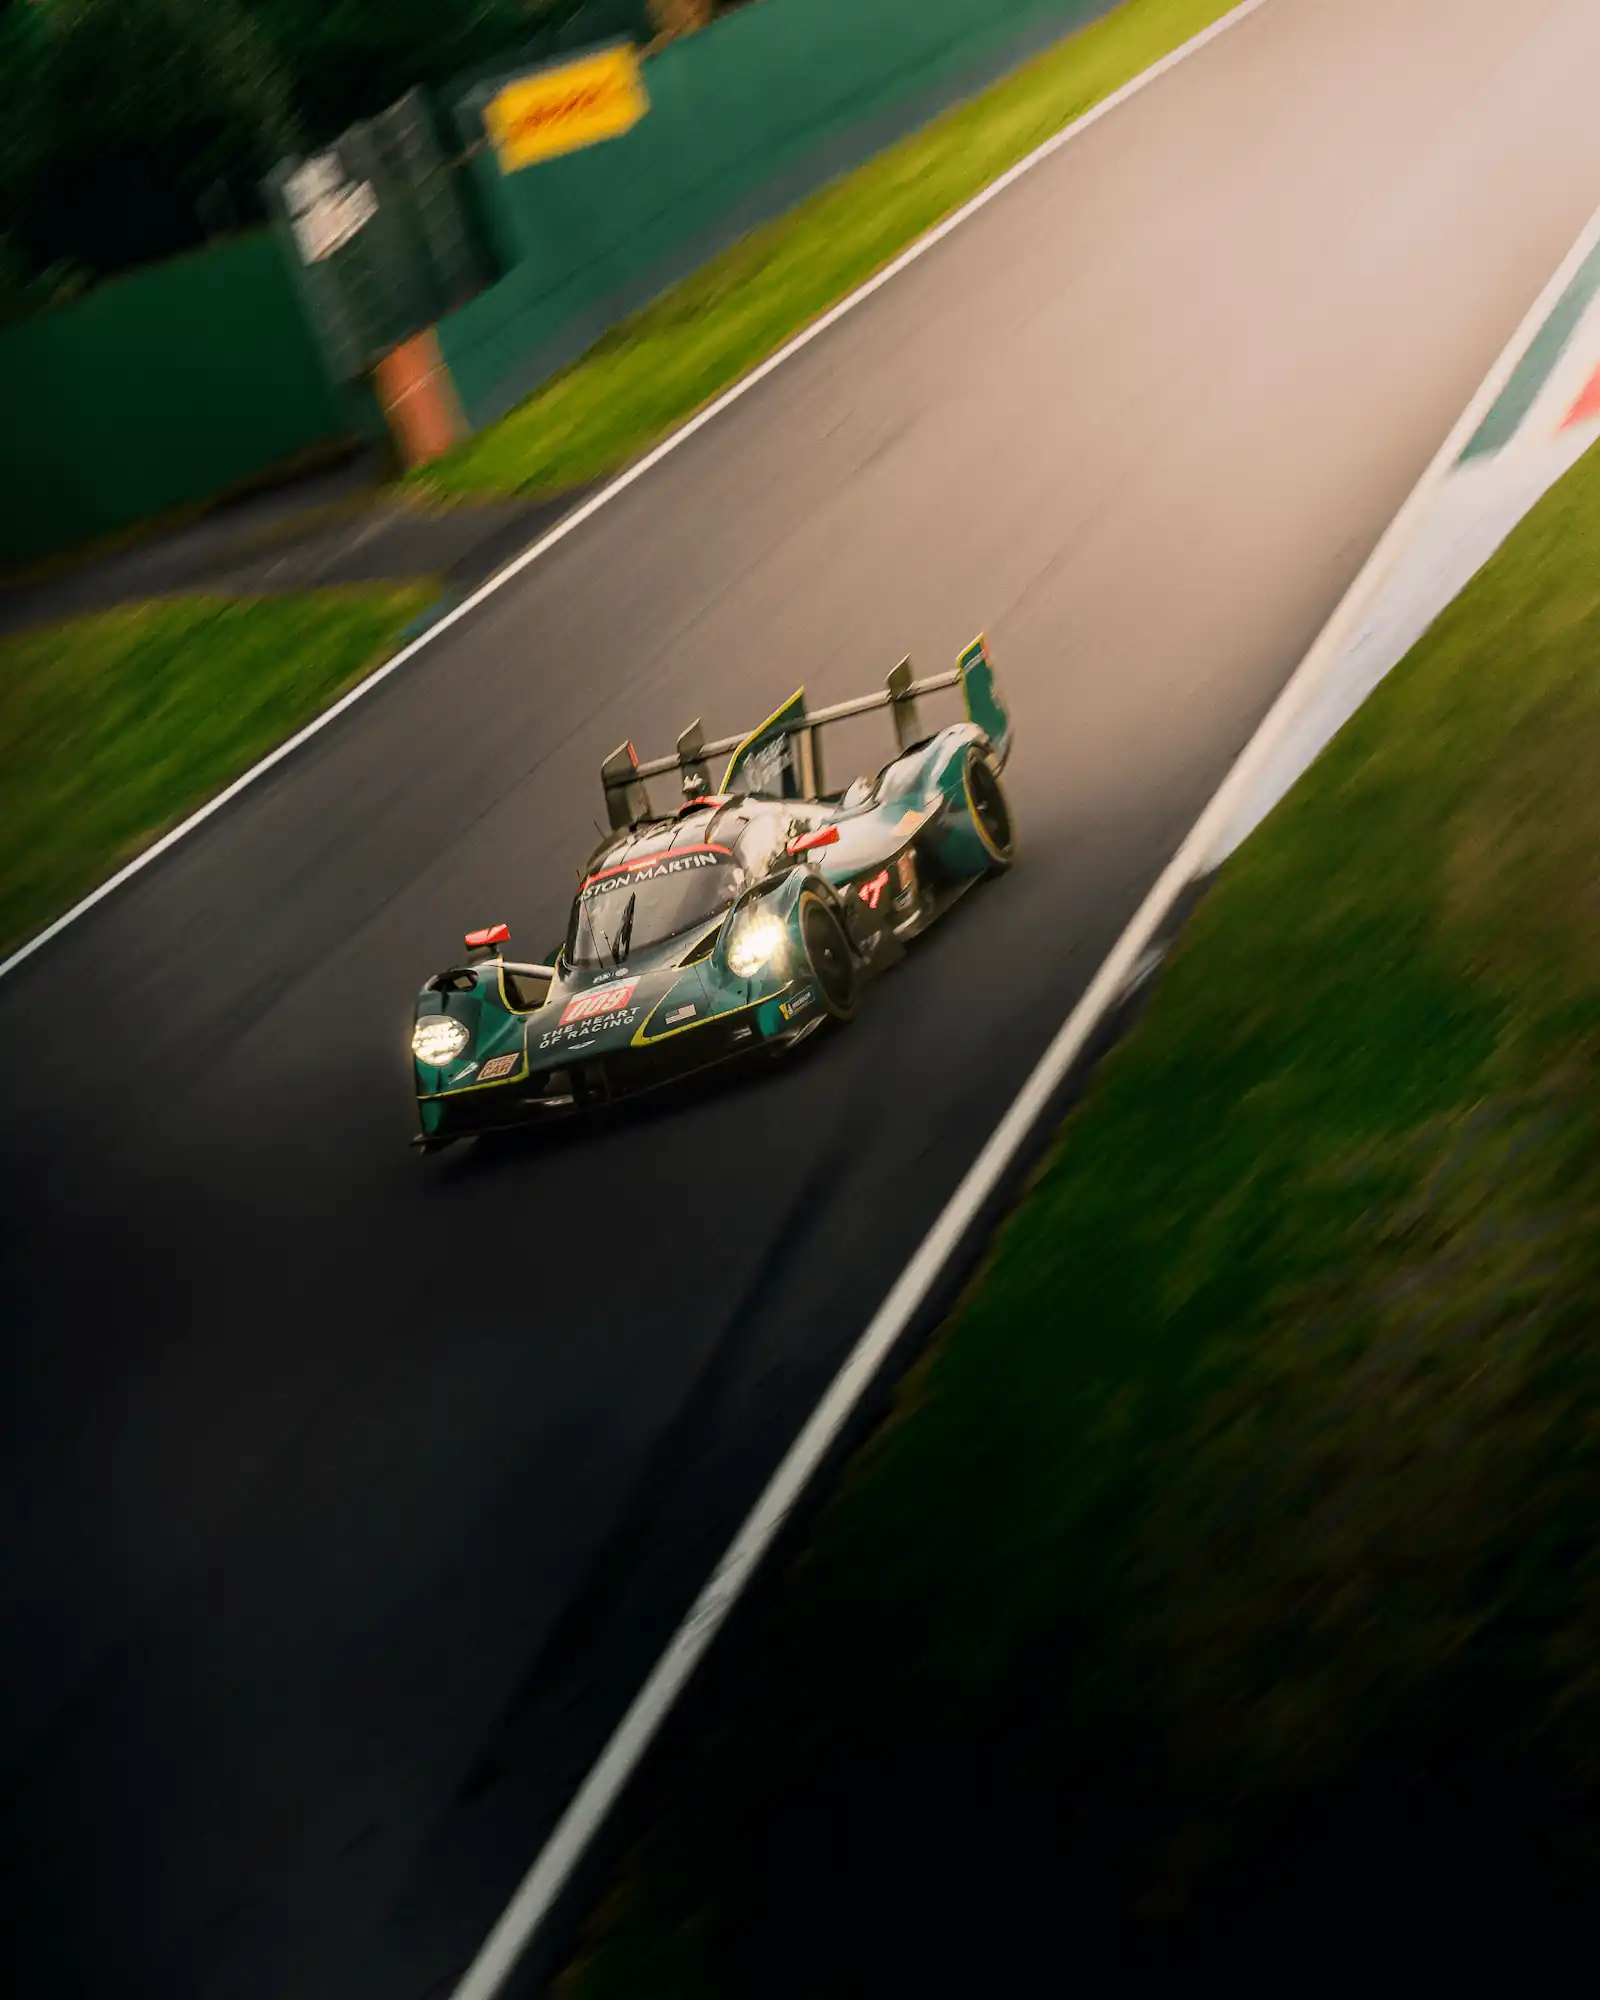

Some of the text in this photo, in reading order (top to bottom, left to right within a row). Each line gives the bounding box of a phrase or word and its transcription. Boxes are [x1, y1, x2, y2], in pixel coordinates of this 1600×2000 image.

[583, 874, 630, 900] STON
[635, 852, 718, 882] MARTIN
[539, 1016, 635, 1049] OF RACING
[542, 1006, 641, 1041] THE HEART
